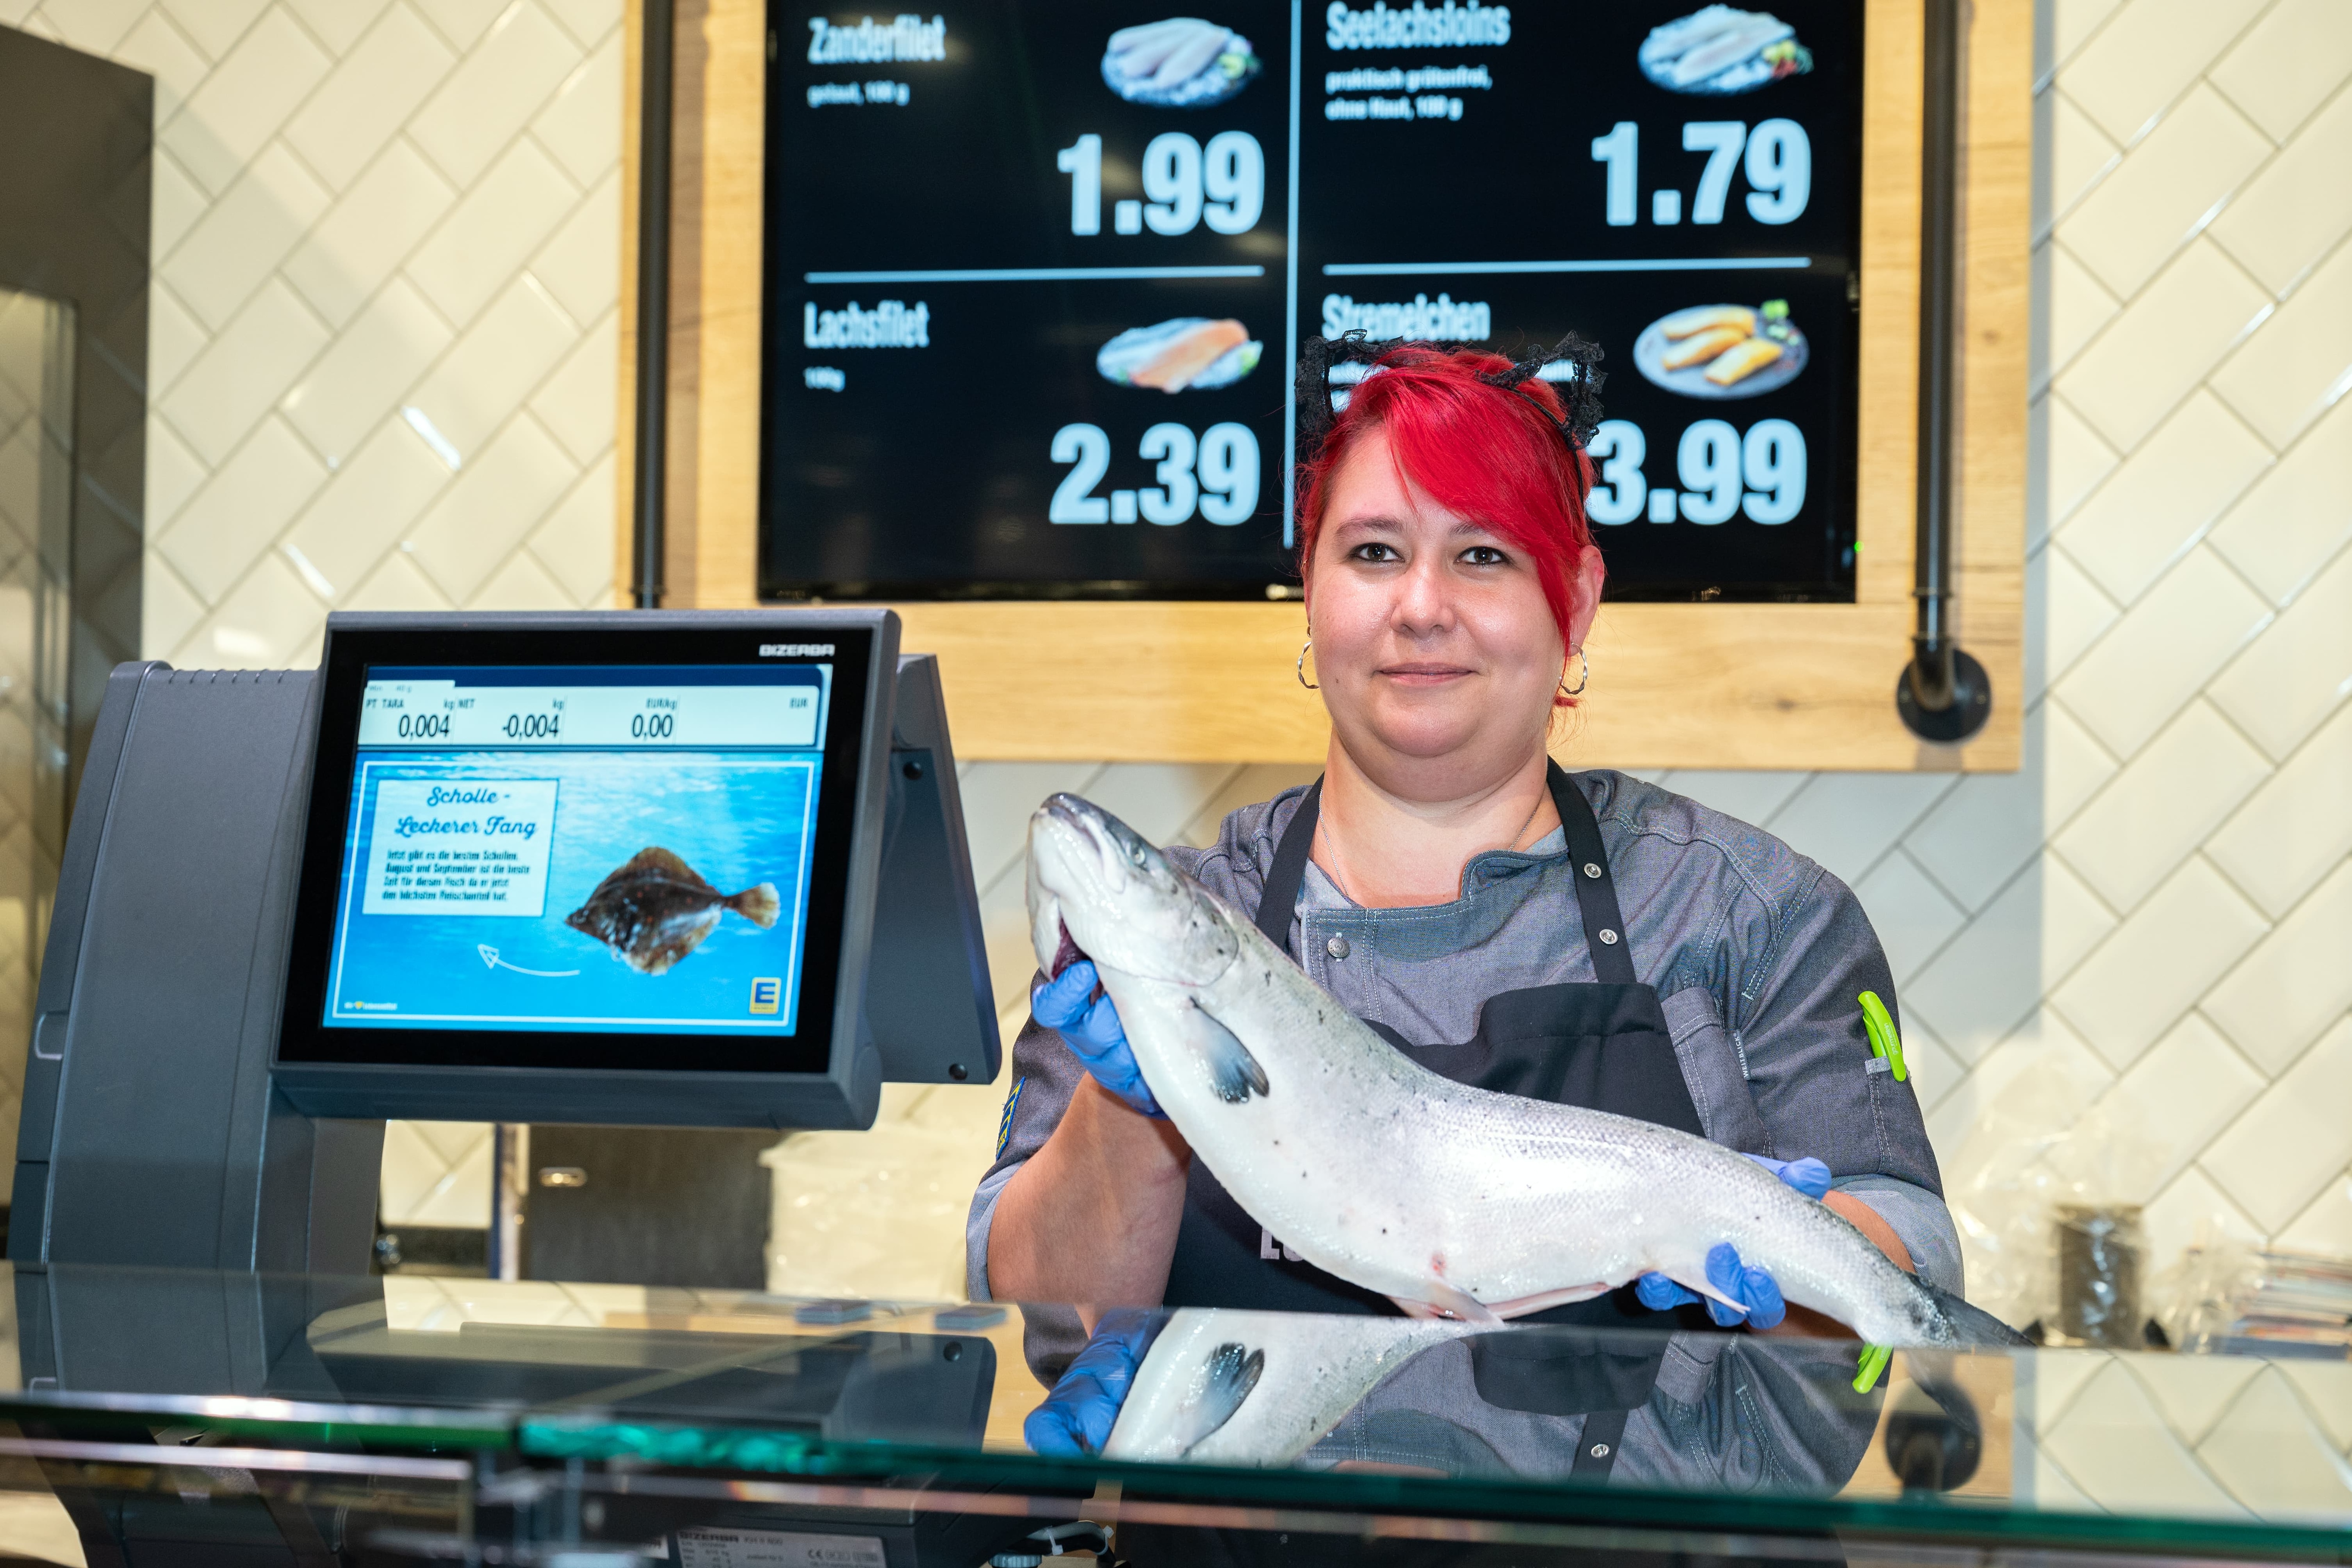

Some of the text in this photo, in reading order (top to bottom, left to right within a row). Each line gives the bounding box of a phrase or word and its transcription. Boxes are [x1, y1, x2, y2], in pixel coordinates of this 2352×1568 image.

[809, 15, 946, 63] Zanderfilet
[1327, 0, 1510, 49] Seelachsloins
[1058, 131, 1265, 236] 1.99
[1592, 119, 1811, 225] 1.79
[804, 301, 929, 348] Lachsfilet
[1322, 293, 1490, 342] Stremelchen
[1049, 423, 1260, 525] 2.39
[1585, 419, 1808, 525] 3.99
[759, 645, 835, 657] BIZERBA
[382, 699, 405, 708] TARA
[398, 714, 450, 741] 0,004
[502, 714, 559, 741] -0,004
[632, 715, 673, 740] 0,00
[427, 787, 498, 806] Scholle
[395, 816, 536, 839] Leckerer Fang
[755, 982, 776, 1004] E
